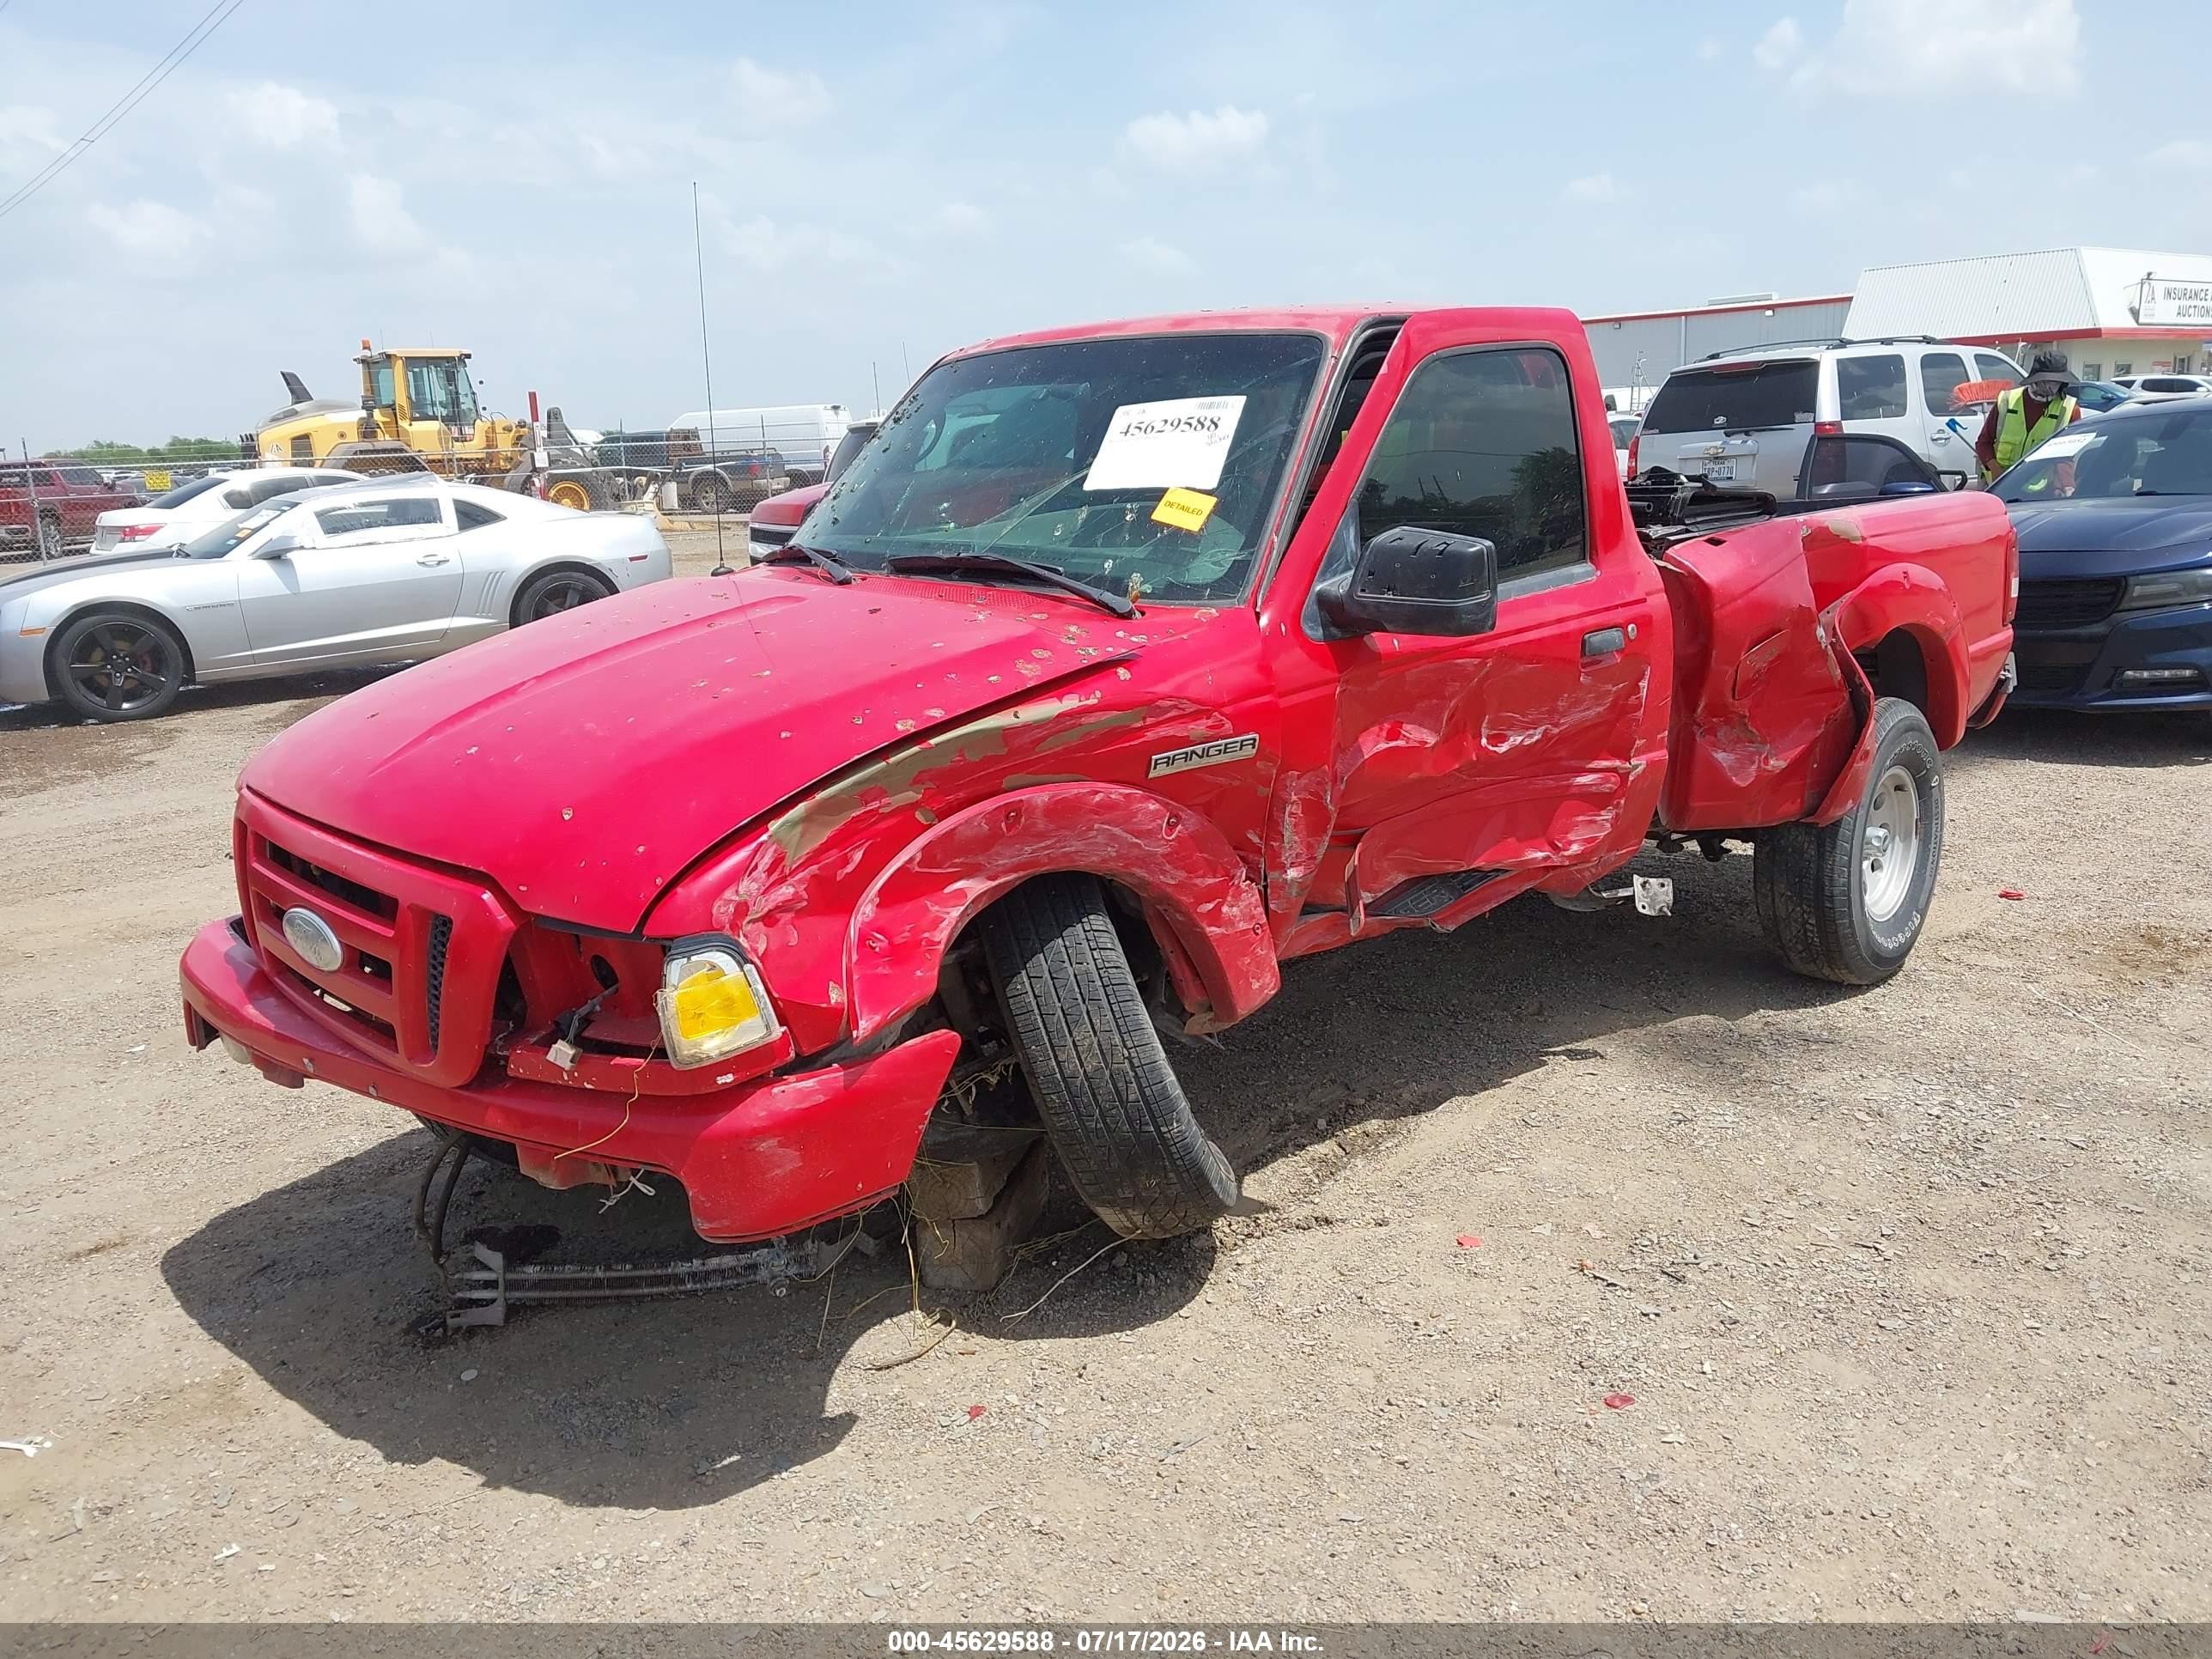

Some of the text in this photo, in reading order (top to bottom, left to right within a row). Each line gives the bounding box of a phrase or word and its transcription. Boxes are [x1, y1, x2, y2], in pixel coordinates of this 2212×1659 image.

[2163, 286, 2209, 301] INSURANCE
[1119, 415, 1221, 437] 45629588
[1164, 501, 1203, 516] DETAILED
[1152, 738, 1257, 770] RANGER
